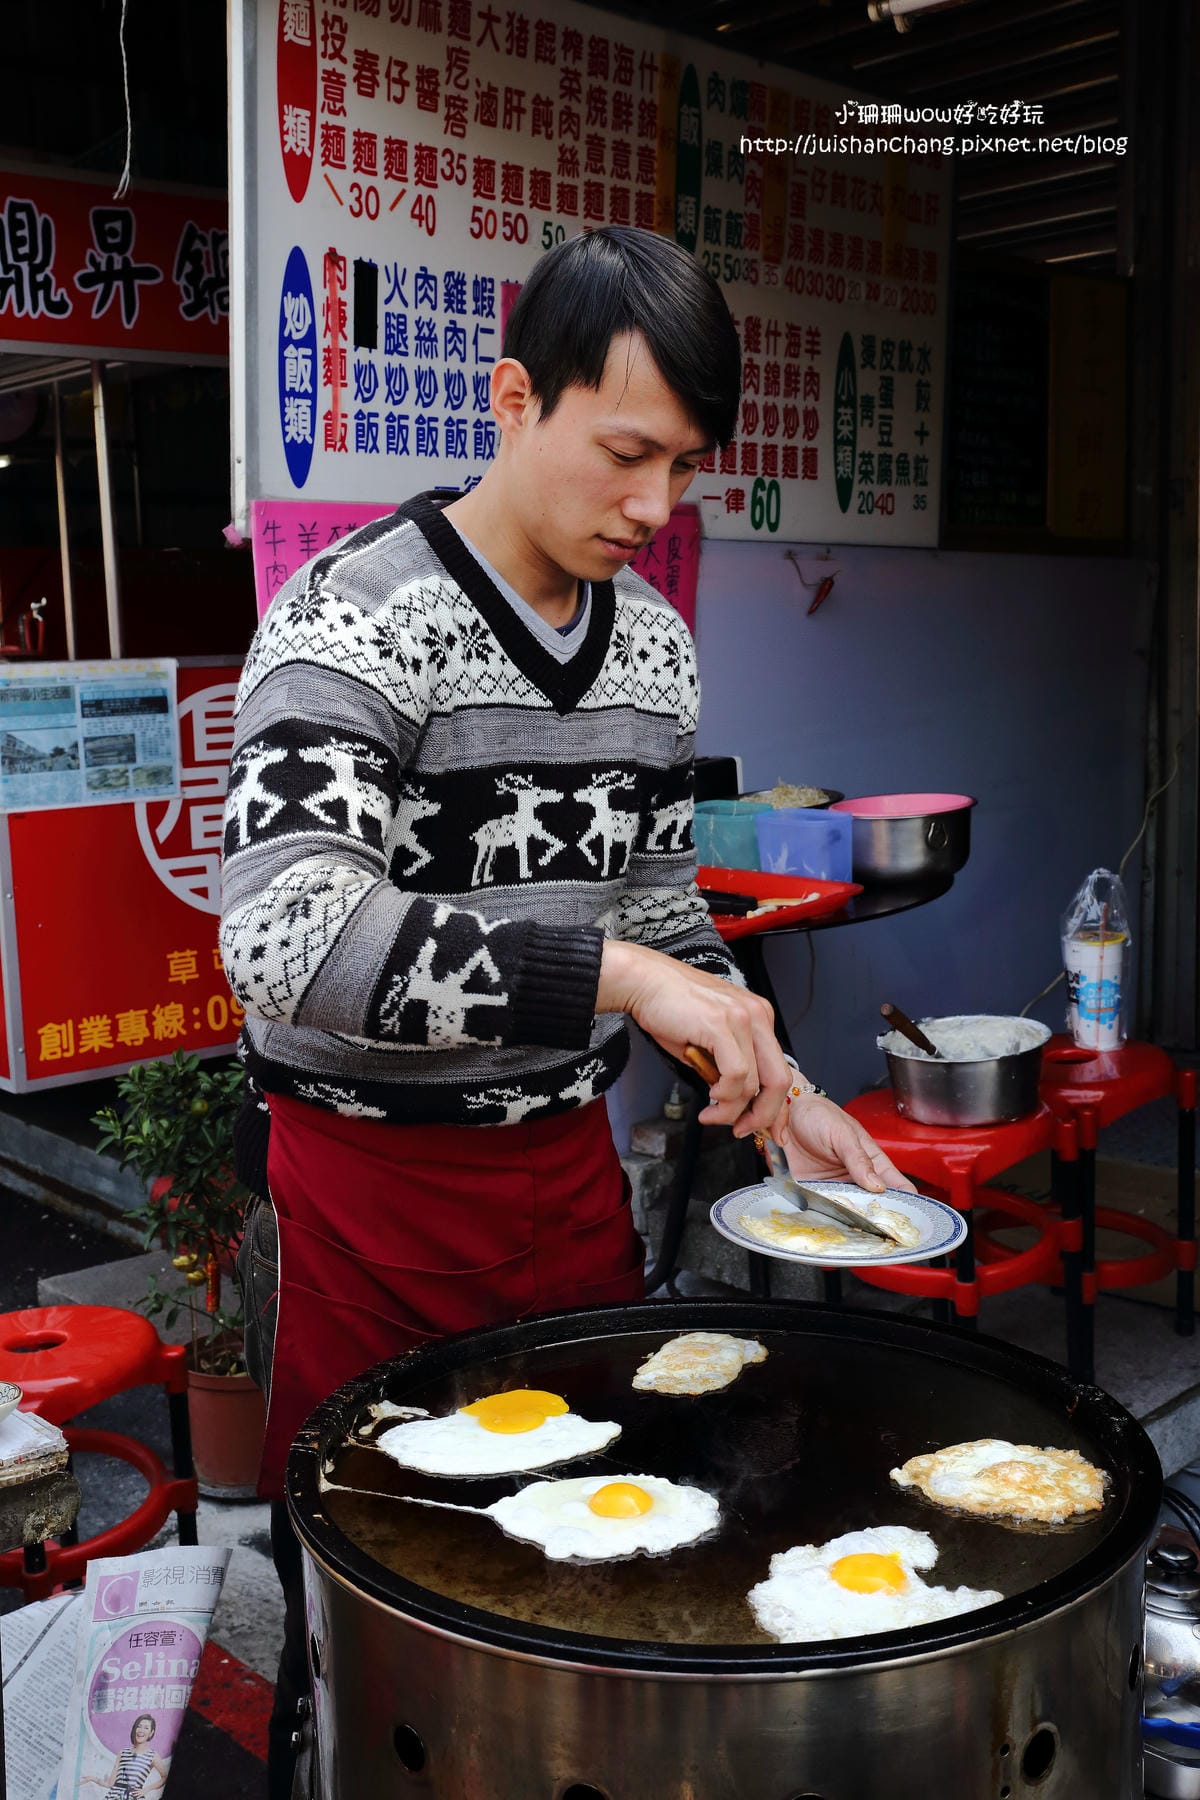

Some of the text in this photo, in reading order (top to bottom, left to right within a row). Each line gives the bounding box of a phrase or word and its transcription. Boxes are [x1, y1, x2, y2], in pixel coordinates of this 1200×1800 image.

[350, 183, 379, 220] 30
[411, 194, 435, 236] 40
[470, 206, 497, 239] 50
[503, 212, 528, 244] 50
[440, 148, 467, 186] 35
[283, 291, 313, 444] 炒飯類
[384, 262, 410, 456] 火腿炒飯
[414, 266, 439, 458] 肉絲炒飯
[443, 270, 468, 459] 雞肉炒飯
[472, 274, 496, 460] 蝦仁炒飯
[750, 477, 780, 532] 60
[101, 1652, 200, 1683] Selina
